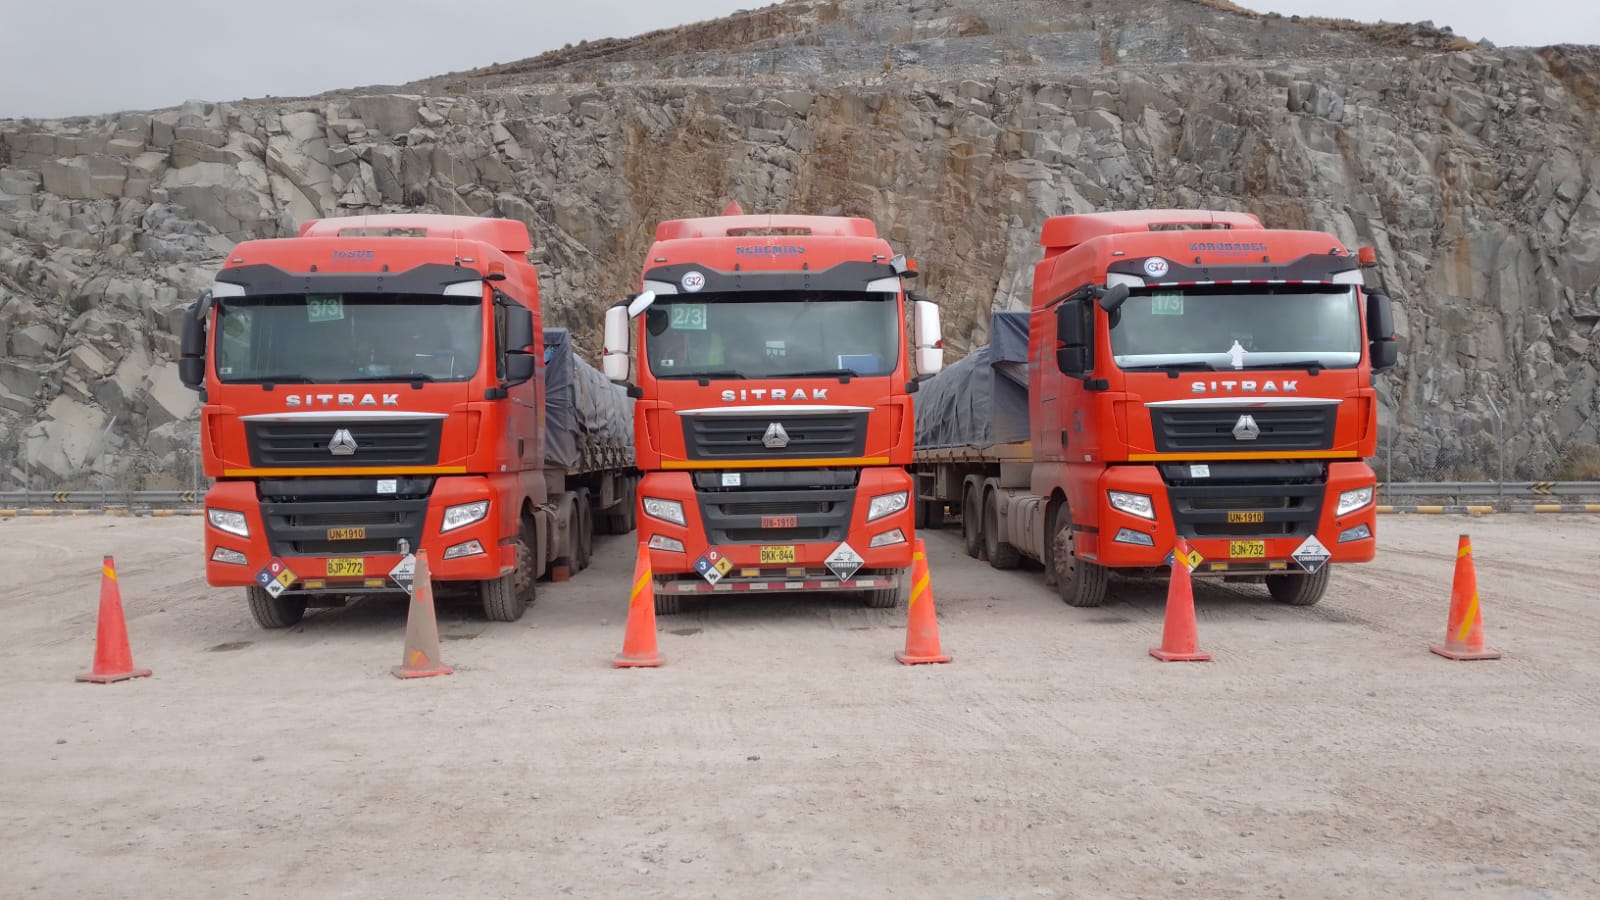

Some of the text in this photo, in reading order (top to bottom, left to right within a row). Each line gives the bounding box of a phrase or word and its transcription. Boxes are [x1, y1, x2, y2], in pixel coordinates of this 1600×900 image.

[310, 299, 338, 317] 3/3
[673, 307, 702, 325] 2/3
[1191, 380, 1298, 394] SITRAK
[285, 393, 399, 407] SITRAK
[721, 388, 828, 402] SITRAK
[1230, 512, 1263, 522] UN-1910
[329, 529, 363, 539] UN-1910
[761, 550, 794, 561] BKK-844
[1231, 544, 1264, 556] BJN-732
[1191, 554, 1196, 563] 1
[271, 563, 279, 572] 0
[327, 562, 363, 574] BJP-772
[700, 561, 707, 570] 3
[720, 562, 726, 570] 1
[261, 573, 269, 582] 3
